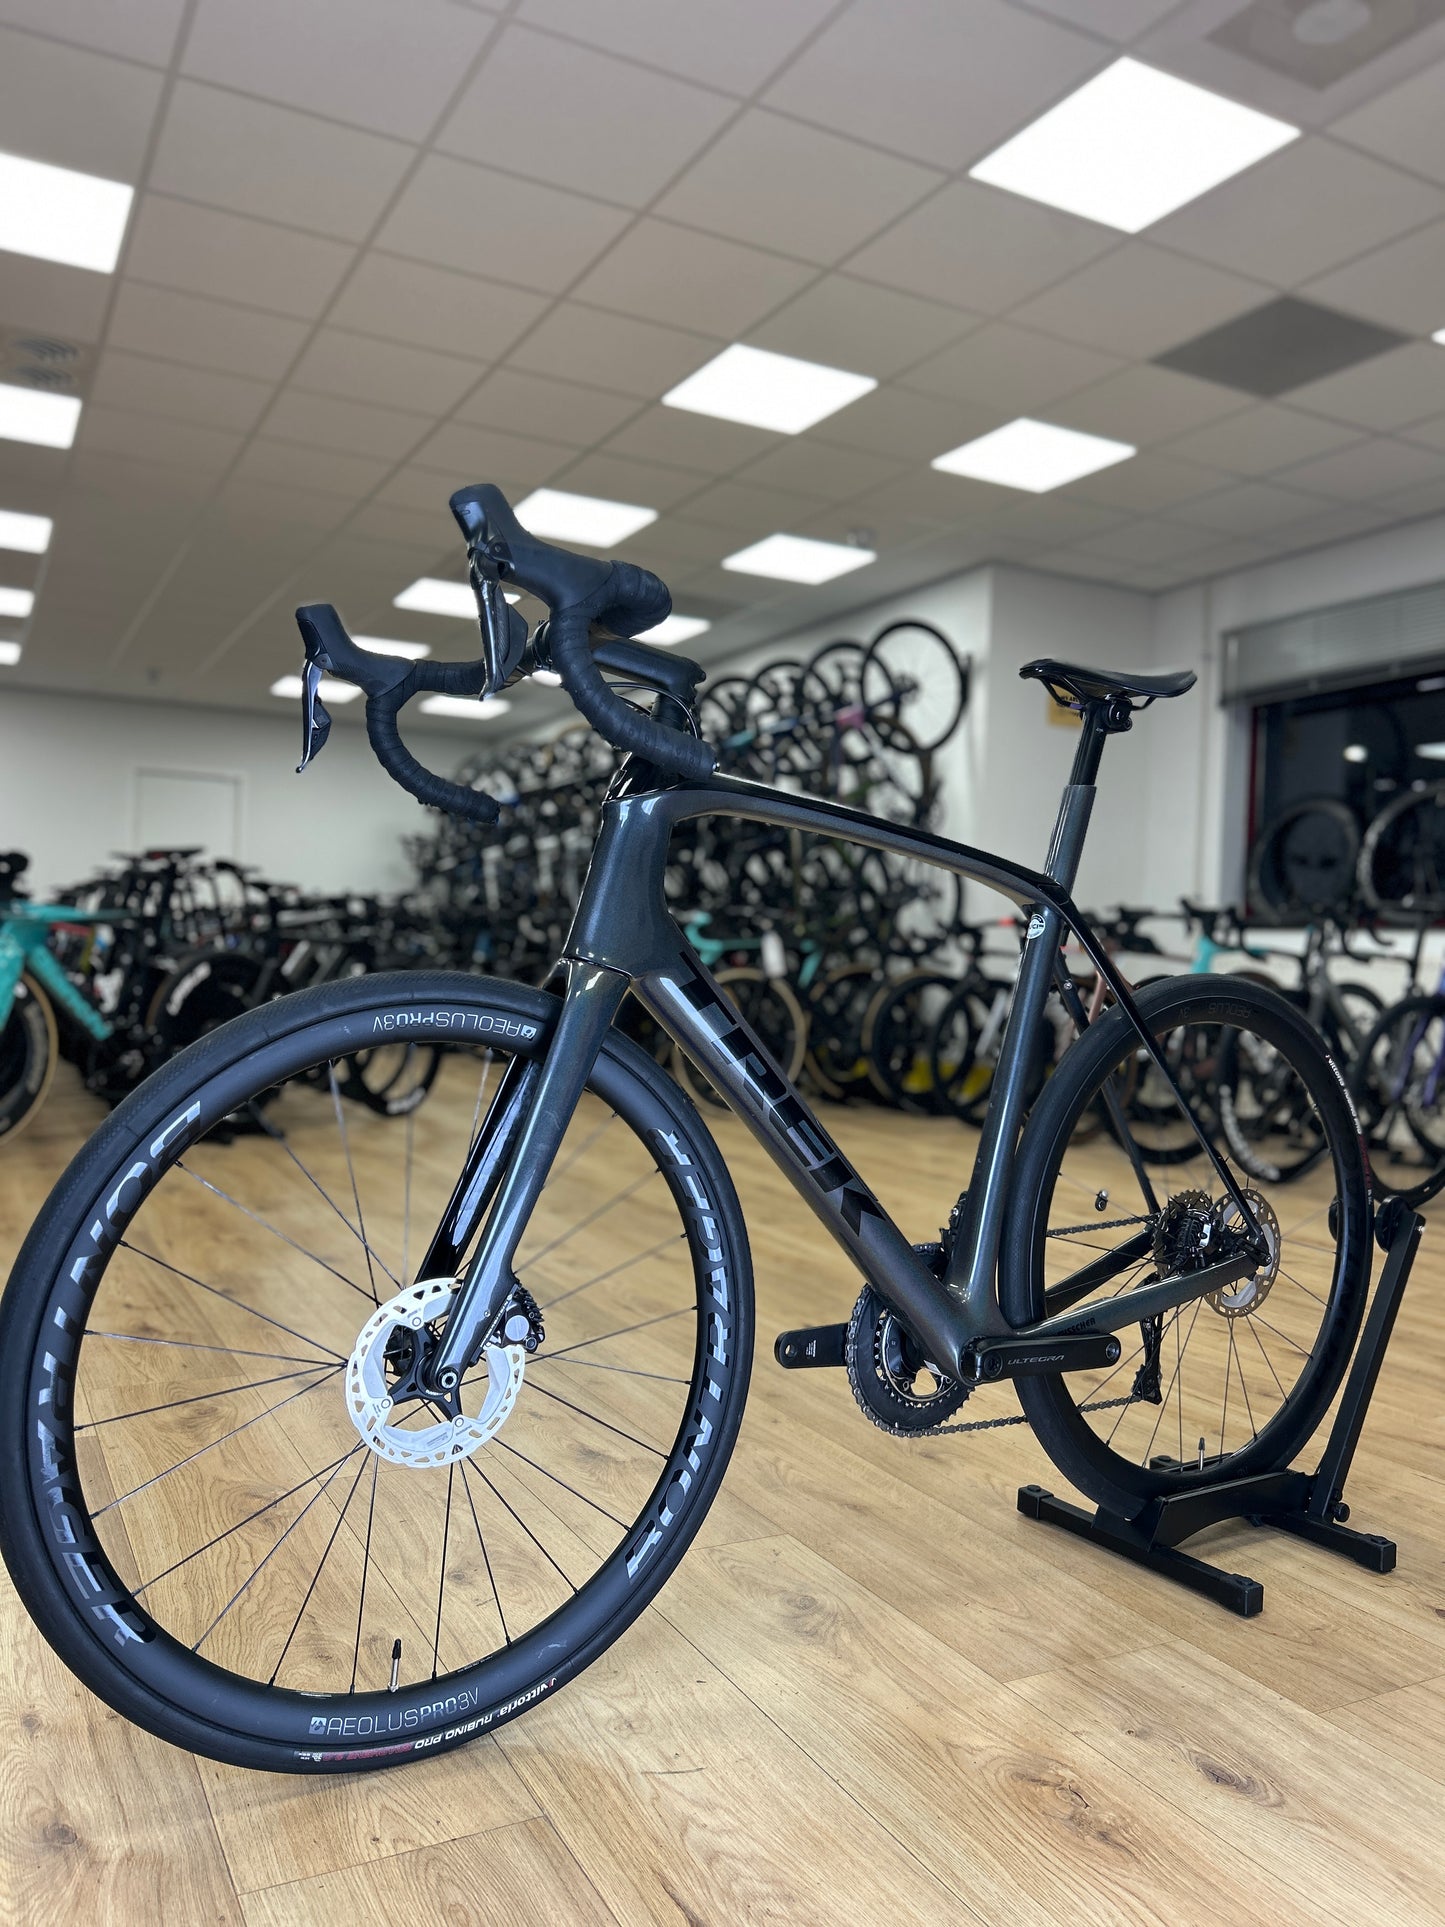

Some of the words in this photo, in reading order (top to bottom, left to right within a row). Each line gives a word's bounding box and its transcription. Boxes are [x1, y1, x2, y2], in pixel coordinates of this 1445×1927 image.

[679, 951, 887, 1237] TREK
[37, 1100, 201, 1647] BONTRAGER
[625, 1127, 733, 1580] BONTRAGER
[1007, 1354, 1065, 1365] ULTEGRA
[414, 1733, 443, 1750] PRO
[444, 1714, 493, 1741] RUBINO
